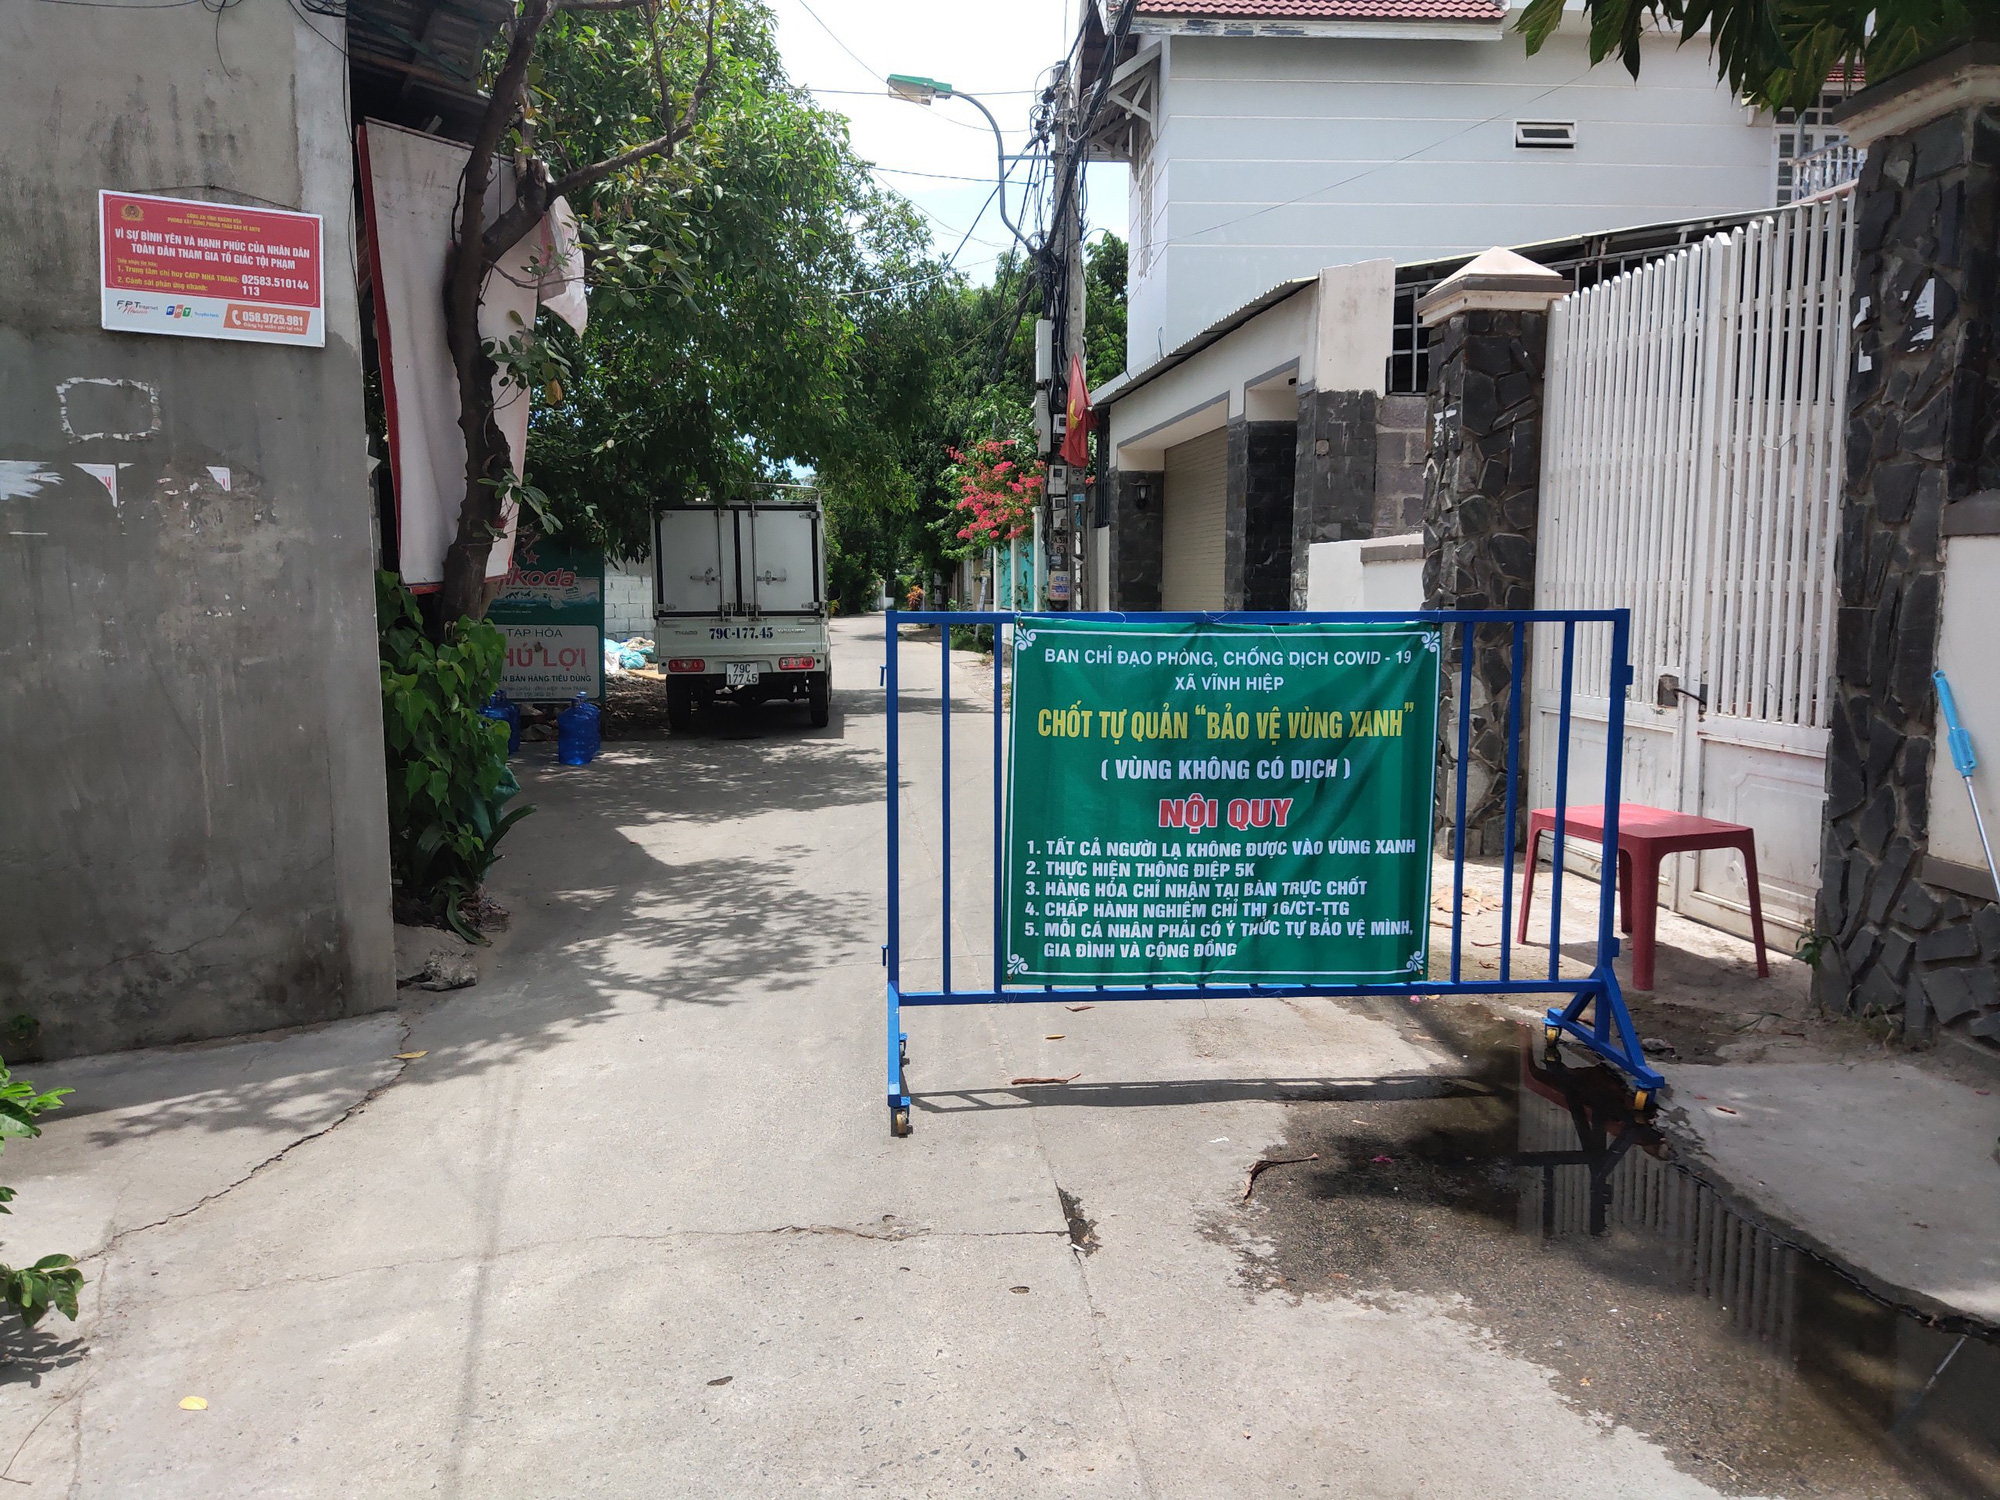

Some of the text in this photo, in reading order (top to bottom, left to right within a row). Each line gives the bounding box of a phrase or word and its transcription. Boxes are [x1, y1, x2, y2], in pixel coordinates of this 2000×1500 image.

[115, 227, 310, 258] VÌ SỰ BÌNH YÊN VÀ HẠNH PHÚC CỦA NHÂN DÂN
[132, 242, 154, 255] TOÀN
[178, 248, 202, 260] THAM
[204, 251, 218, 262] GIA
[221, 250, 231, 263] TỐ
[234, 254, 254, 266] GIÁC
[256, 256, 268, 268] TỘI
[271, 258, 296, 270] PHẠM
[118, 276, 124, 284] 2.
[126, 266, 144, 275] Trung
[184, 271, 200, 279] CATP
[242, 274, 310, 290] 02583.510144
[242, 286, 260, 296] 113
[116, 300, 141, 308] FPT
[166, 304, 191, 318] FPT
[499, 561, 576, 589] ikoda
[506, 627, 563, 639] TẠP HÓA
[709, 626, 774, 640] 79C-177.45
[506, 642, 586, 672] HÚ LỢI
[1044, 648, 1079, 664] BAN
[1084, 644, 1112, 664] CHỈ
[1118, 650, 1152, 668] ĐẠO
[1156, 648, 1218, 667] PHÒNG,
[1223, 646, 1284, 666] CHỐNG
[1288, 650, 1329, 668] DỊCH
[1334, 650, 1381, 665] COVID
[1395, 650, 1412, 664] 19
[528, 674, 550, 682] HÀNG
[570, 674, 592, 682] DÙNG
[733, 664, 750, 674] 79C
[1175, 673, 1284, 694] XÃ VĨNH HIỆP
[1038, 700, 1093, 738] CHỐT
[1099, 708, 1128, 744] TỰ
[1131, 702, 1188, 744] QUẢN
[1256, 706, 1282, 746] VỆ
[1288, 706, 1342, 738] VÙNG
[1115, 755, 1172, 780] VÙNG
[1178, 756, 1250, 780] KHÔNG
[1256, 756, 1284, 780] CÓ
[1291, 758, 1338, 783] DỊCH
[1158, 792, 1294, 834] NỘI QUY
[1027, 836, 1416, 860] 1. TẤT CẢ NGƯỜI LẠ KHÔNG ĐƯỢC VÀO VÙNG XANH
[1026, 860, 1256, 880] 2. THỰC HIỆN THÔNG ĐIỆP 5K
[1025, 876, 1368, 900] 3. HÀNG HÓA CHỈ NHẬN TẠI BÀN TRỰC CHỐT
[1024, 898, 1350, 919] 4. CHẤP HÀNH NGHIÊM CHỈ THỊ 16/CT-TTG
[1024, 918, 1414, 938] 5. MỖI CÁ NHÂN PHẢI CÓ Ý THỨC TỰ BẢO VỆ MÌNH,
[1044, 939, 1237, 960] GIA ĐÌNH VÀ CỘNG ĐỒNG
